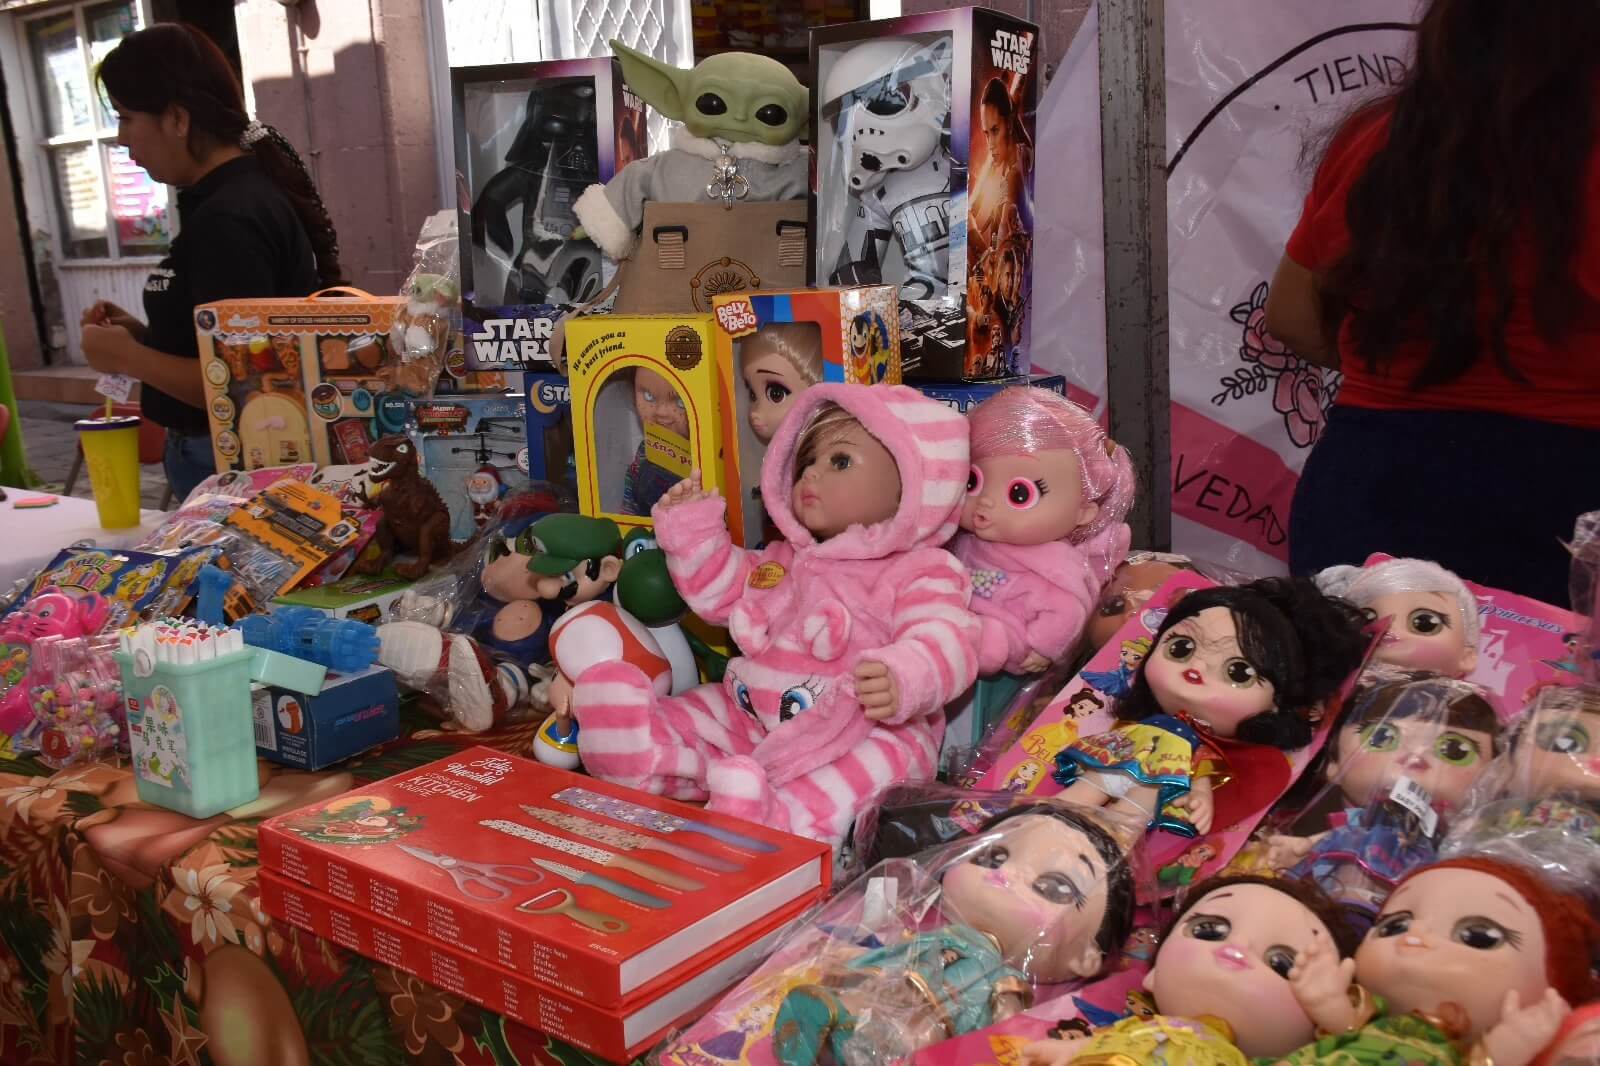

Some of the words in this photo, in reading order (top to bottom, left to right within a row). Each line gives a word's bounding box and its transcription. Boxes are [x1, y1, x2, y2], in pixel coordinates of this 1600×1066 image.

[991, 29, 1032, 57] STAR
[991, 47, 1031, 75] WARS
[473, 318, 554, 340] STAR
[573, 358, 582, 371] He
[580, 338, 600, 359] wants
[600, 332, 615, 344] you
[584, 352, 599, 371] best
[1174, 453, 1286, 545] VEDAD
[470, 757, 515, 776] Feliz
[393, 781, 433, 797] KNIFE
[408, 775, 482, 802] KITCHEN
